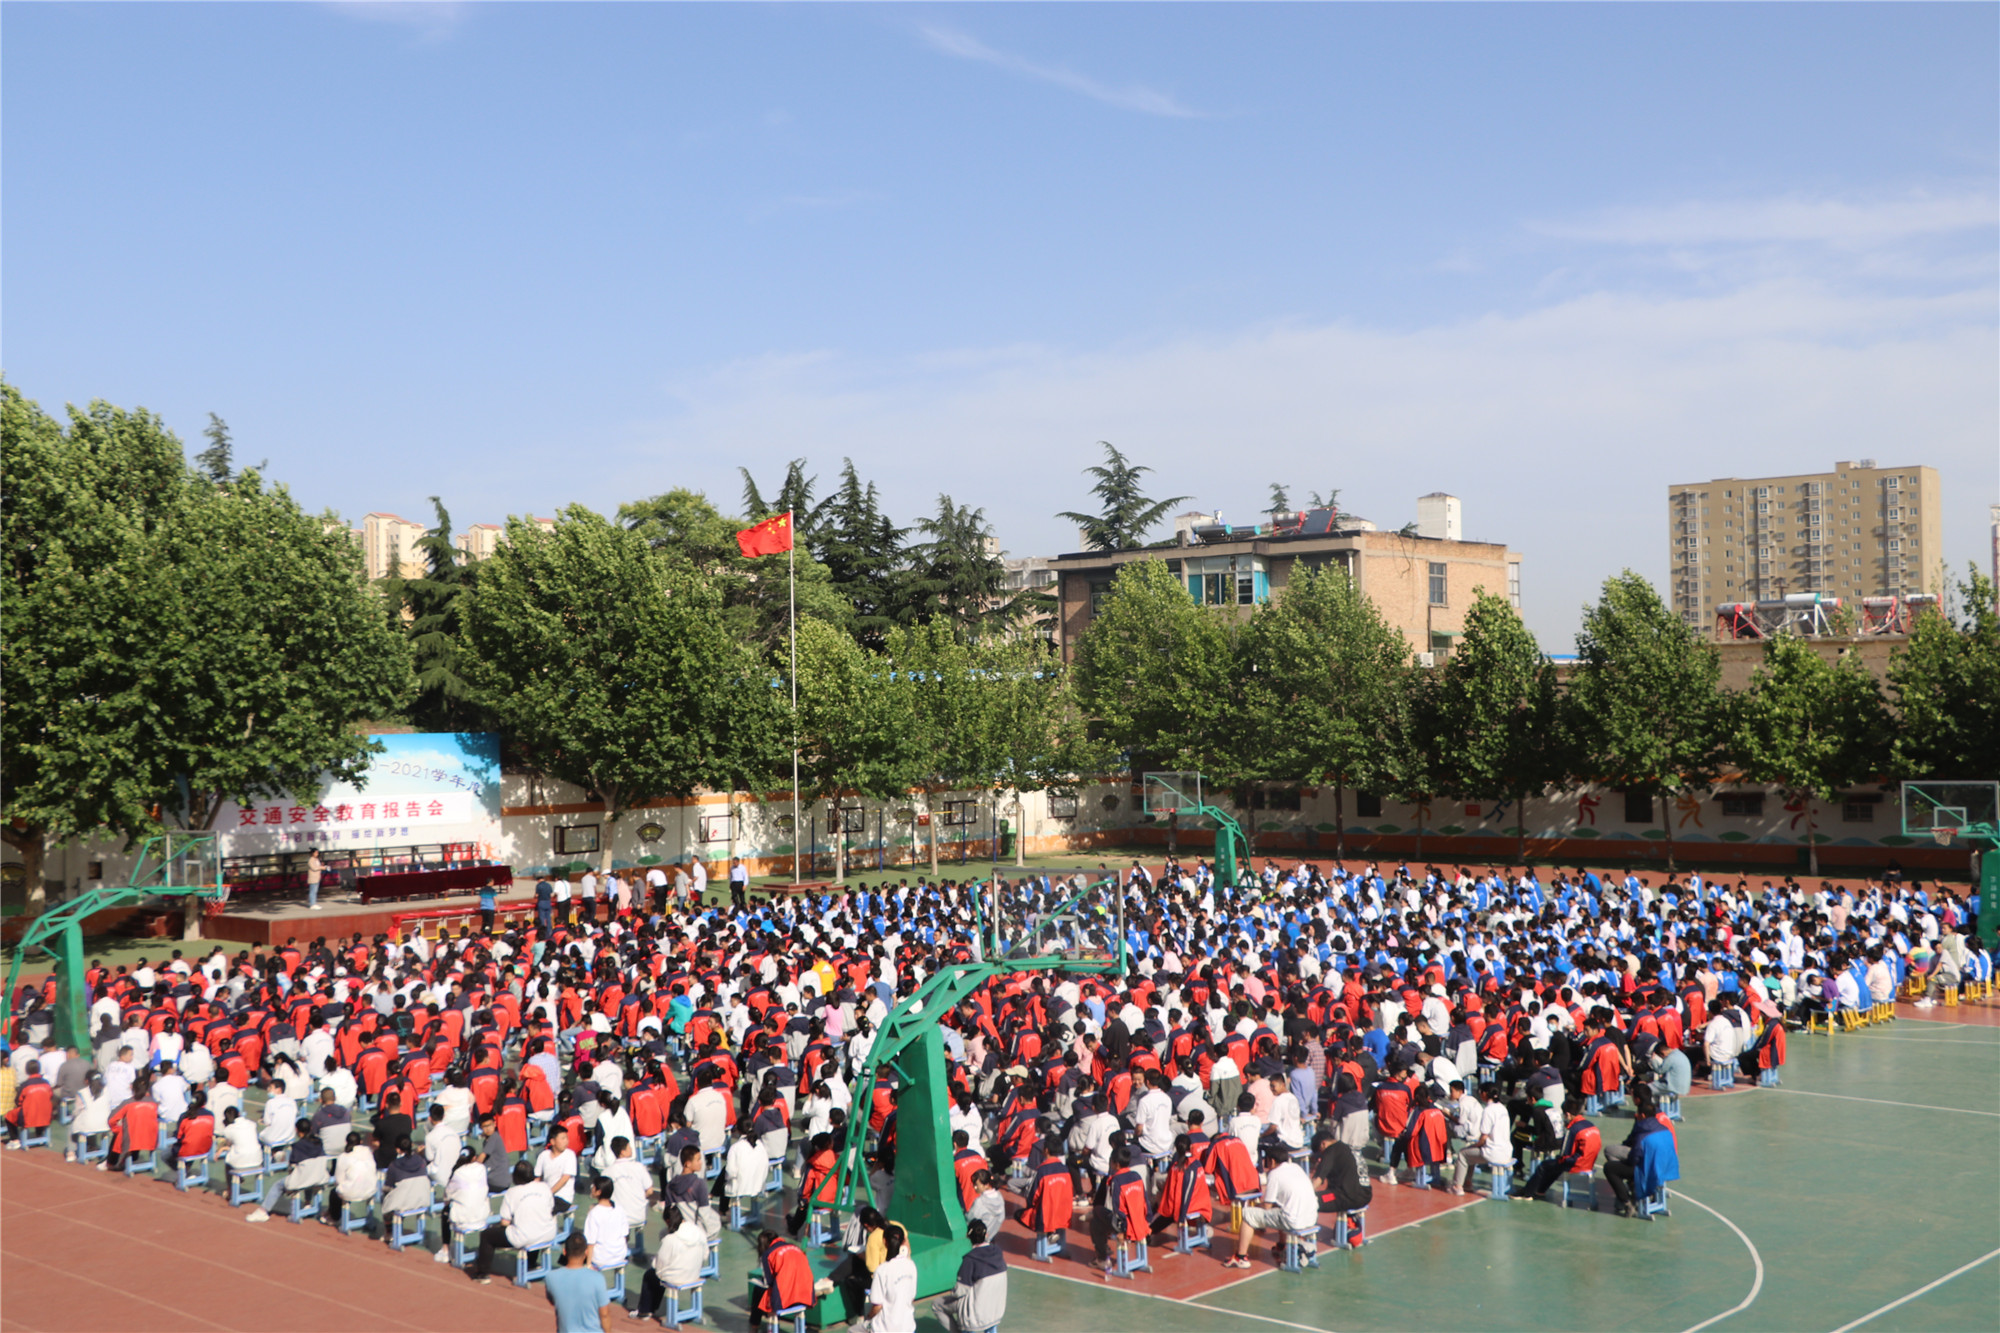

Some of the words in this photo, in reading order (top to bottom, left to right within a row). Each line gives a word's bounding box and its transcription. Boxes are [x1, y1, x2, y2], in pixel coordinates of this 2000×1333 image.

[368, 759, 482, 797] 0-2021学年度
[239, 799, 444, 826] 交通安全教育报告会
